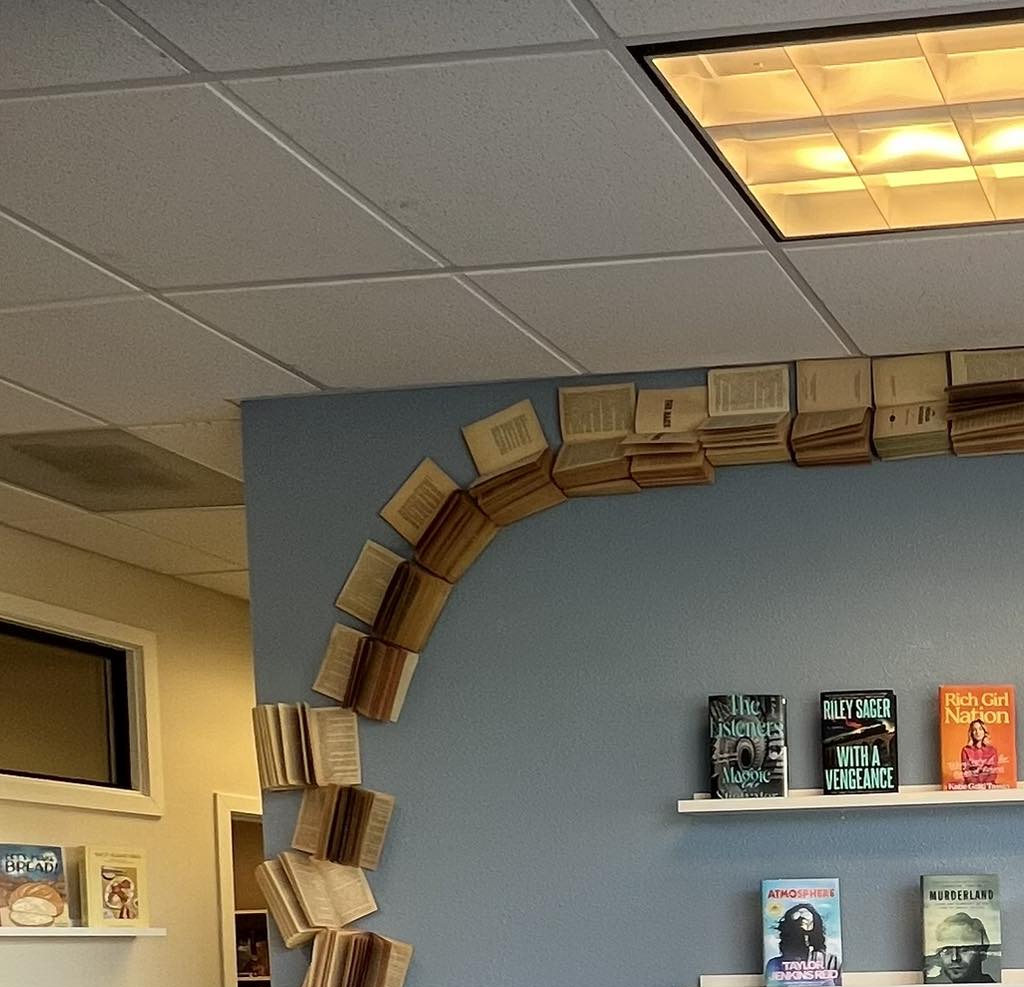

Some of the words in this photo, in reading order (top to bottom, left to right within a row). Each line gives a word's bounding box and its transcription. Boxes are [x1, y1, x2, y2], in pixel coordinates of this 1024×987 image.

[728, 694, 761, 716] The
[944, 692, 978, 708] Rich
[981, 691, 1009, 707] Girl
[823, 699, 853, 720] RILEY
[855, 698, 891, 719] SAGER
[944, 707, 1010, 724] Nation
[710, 717, 784, 738] Listeners
[836, 745, 869, 768] WITH
[871, 745, 881, 767] A
[722, 766, 772, 788] Maggie
[824, 767, 895, 791] VENGEANCE
[6, 861, 58, 873] BREAD!
[768, 888, 835, 899] ATMOSPHERE
[929, 889, 994, 901] MURDERLAND
[782, 961, 824, 970] TAYLOR
[771, 971, 814, 980] JENKINS
